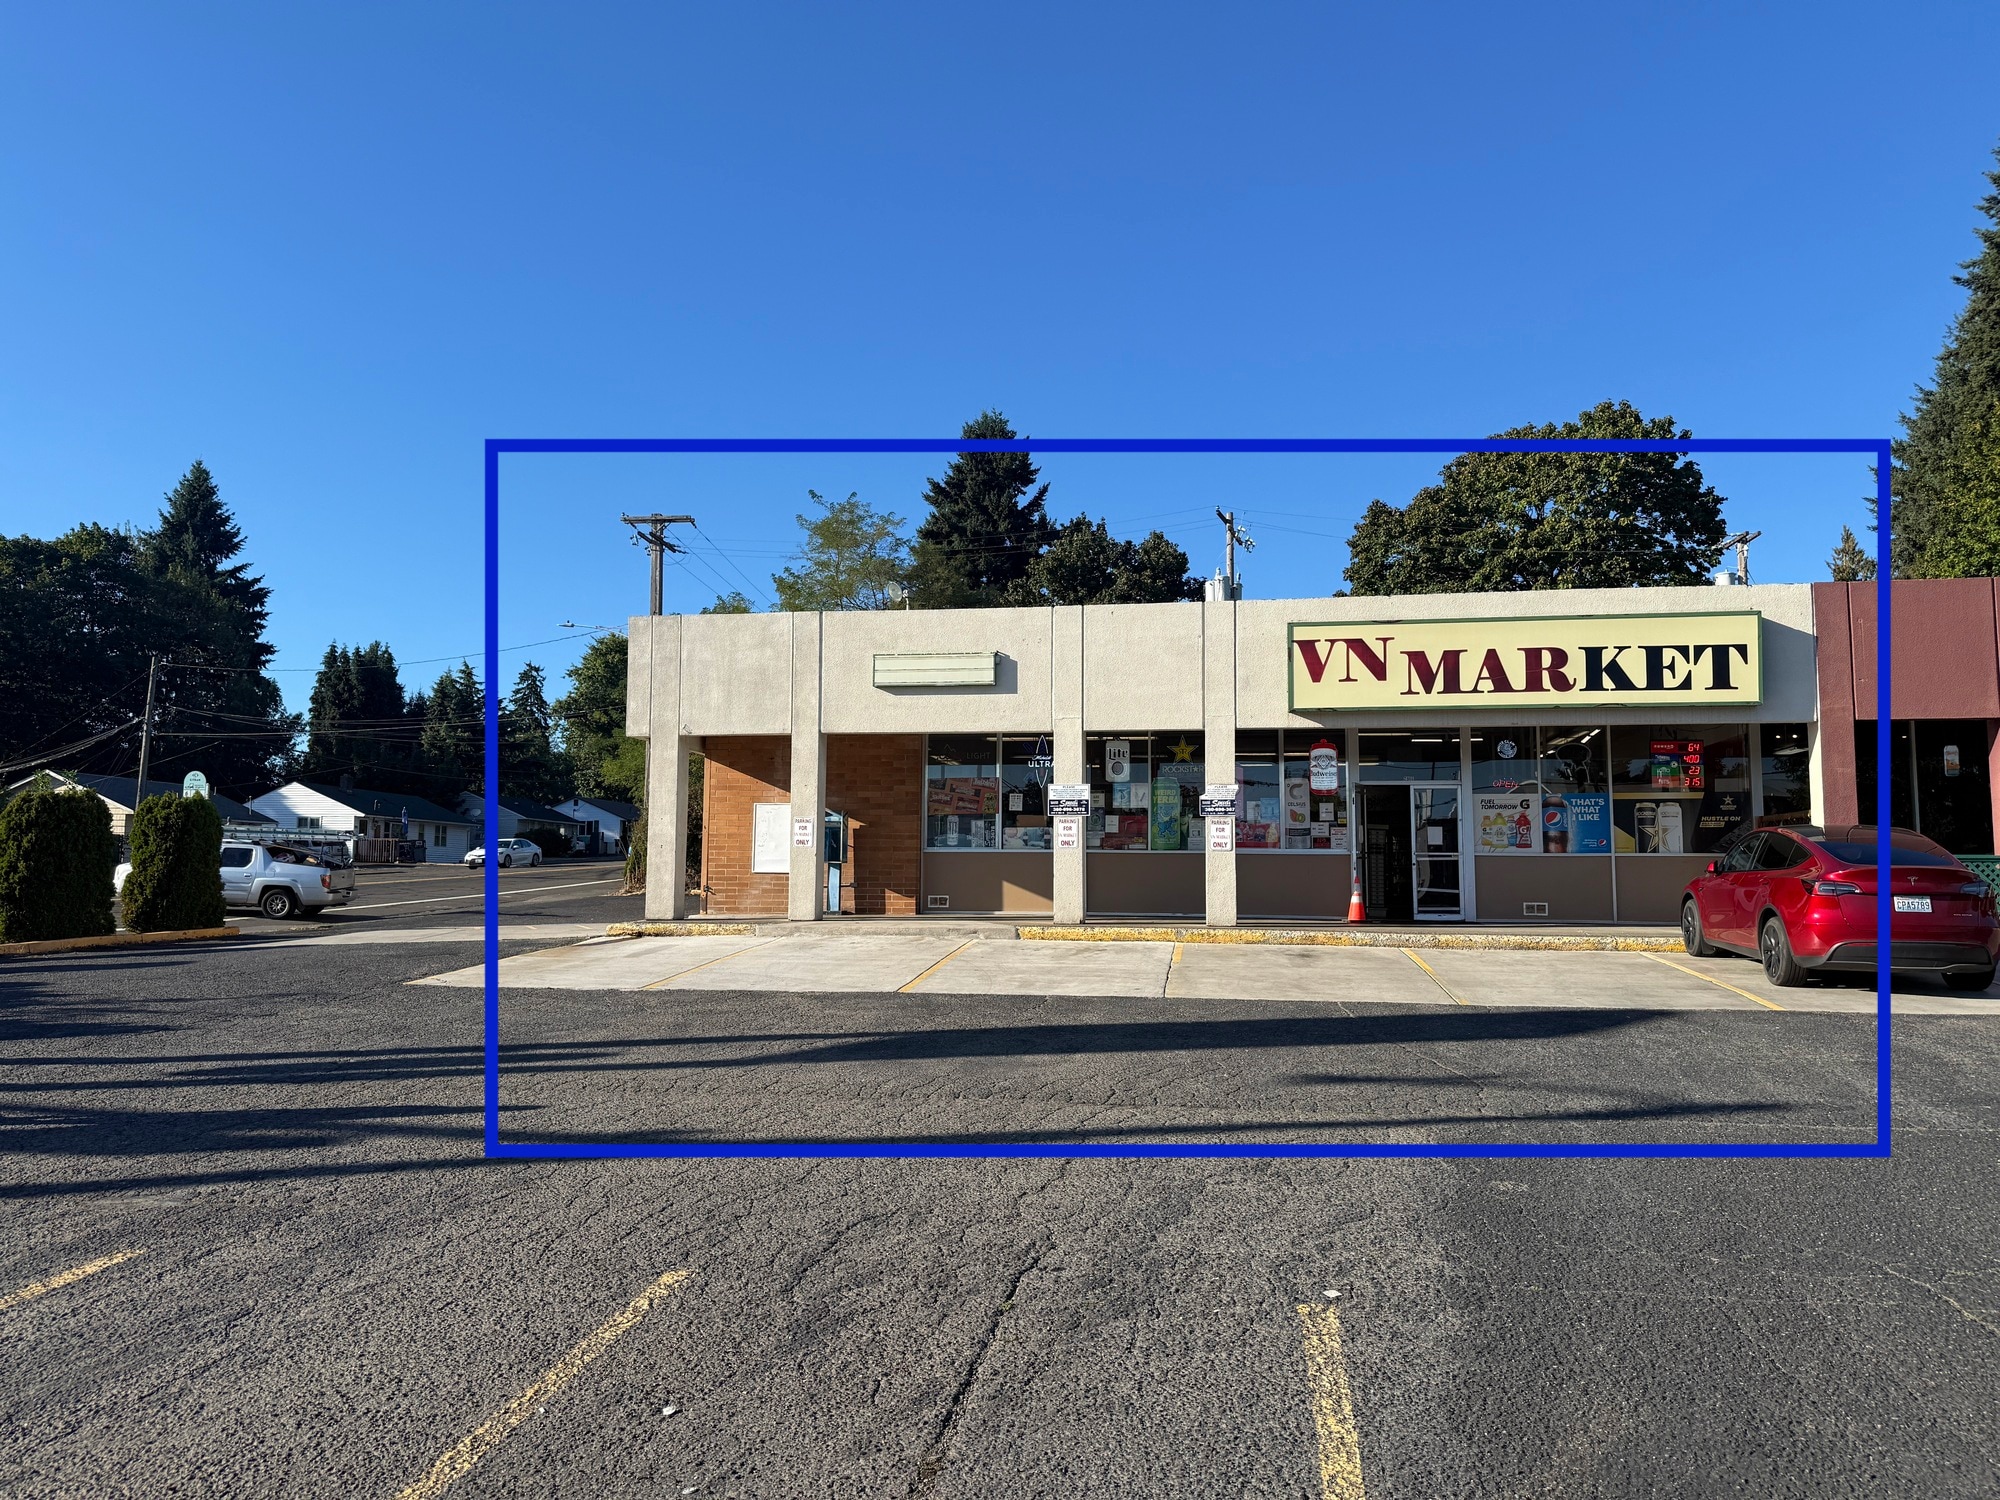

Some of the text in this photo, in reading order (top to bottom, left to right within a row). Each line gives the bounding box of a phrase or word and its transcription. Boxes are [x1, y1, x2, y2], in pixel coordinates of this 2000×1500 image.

[1292, 636, 1749, 696] VN MARKET
[1687, 743, 1700, 752] 64
[1107, 748, 1128, 760] Lite
[1683, 754, 1700, 763] 400
[1028, 760, 1054, 768] ULTRA
[1688, 766, 1701, 775] 23
[1153, 796, 1179, 804] YERBA
[1519, 798, 1531, 810] G
[1570, 798, 1605, 806] THAT'S
[1578, 813, 1600, 821] LIKE
